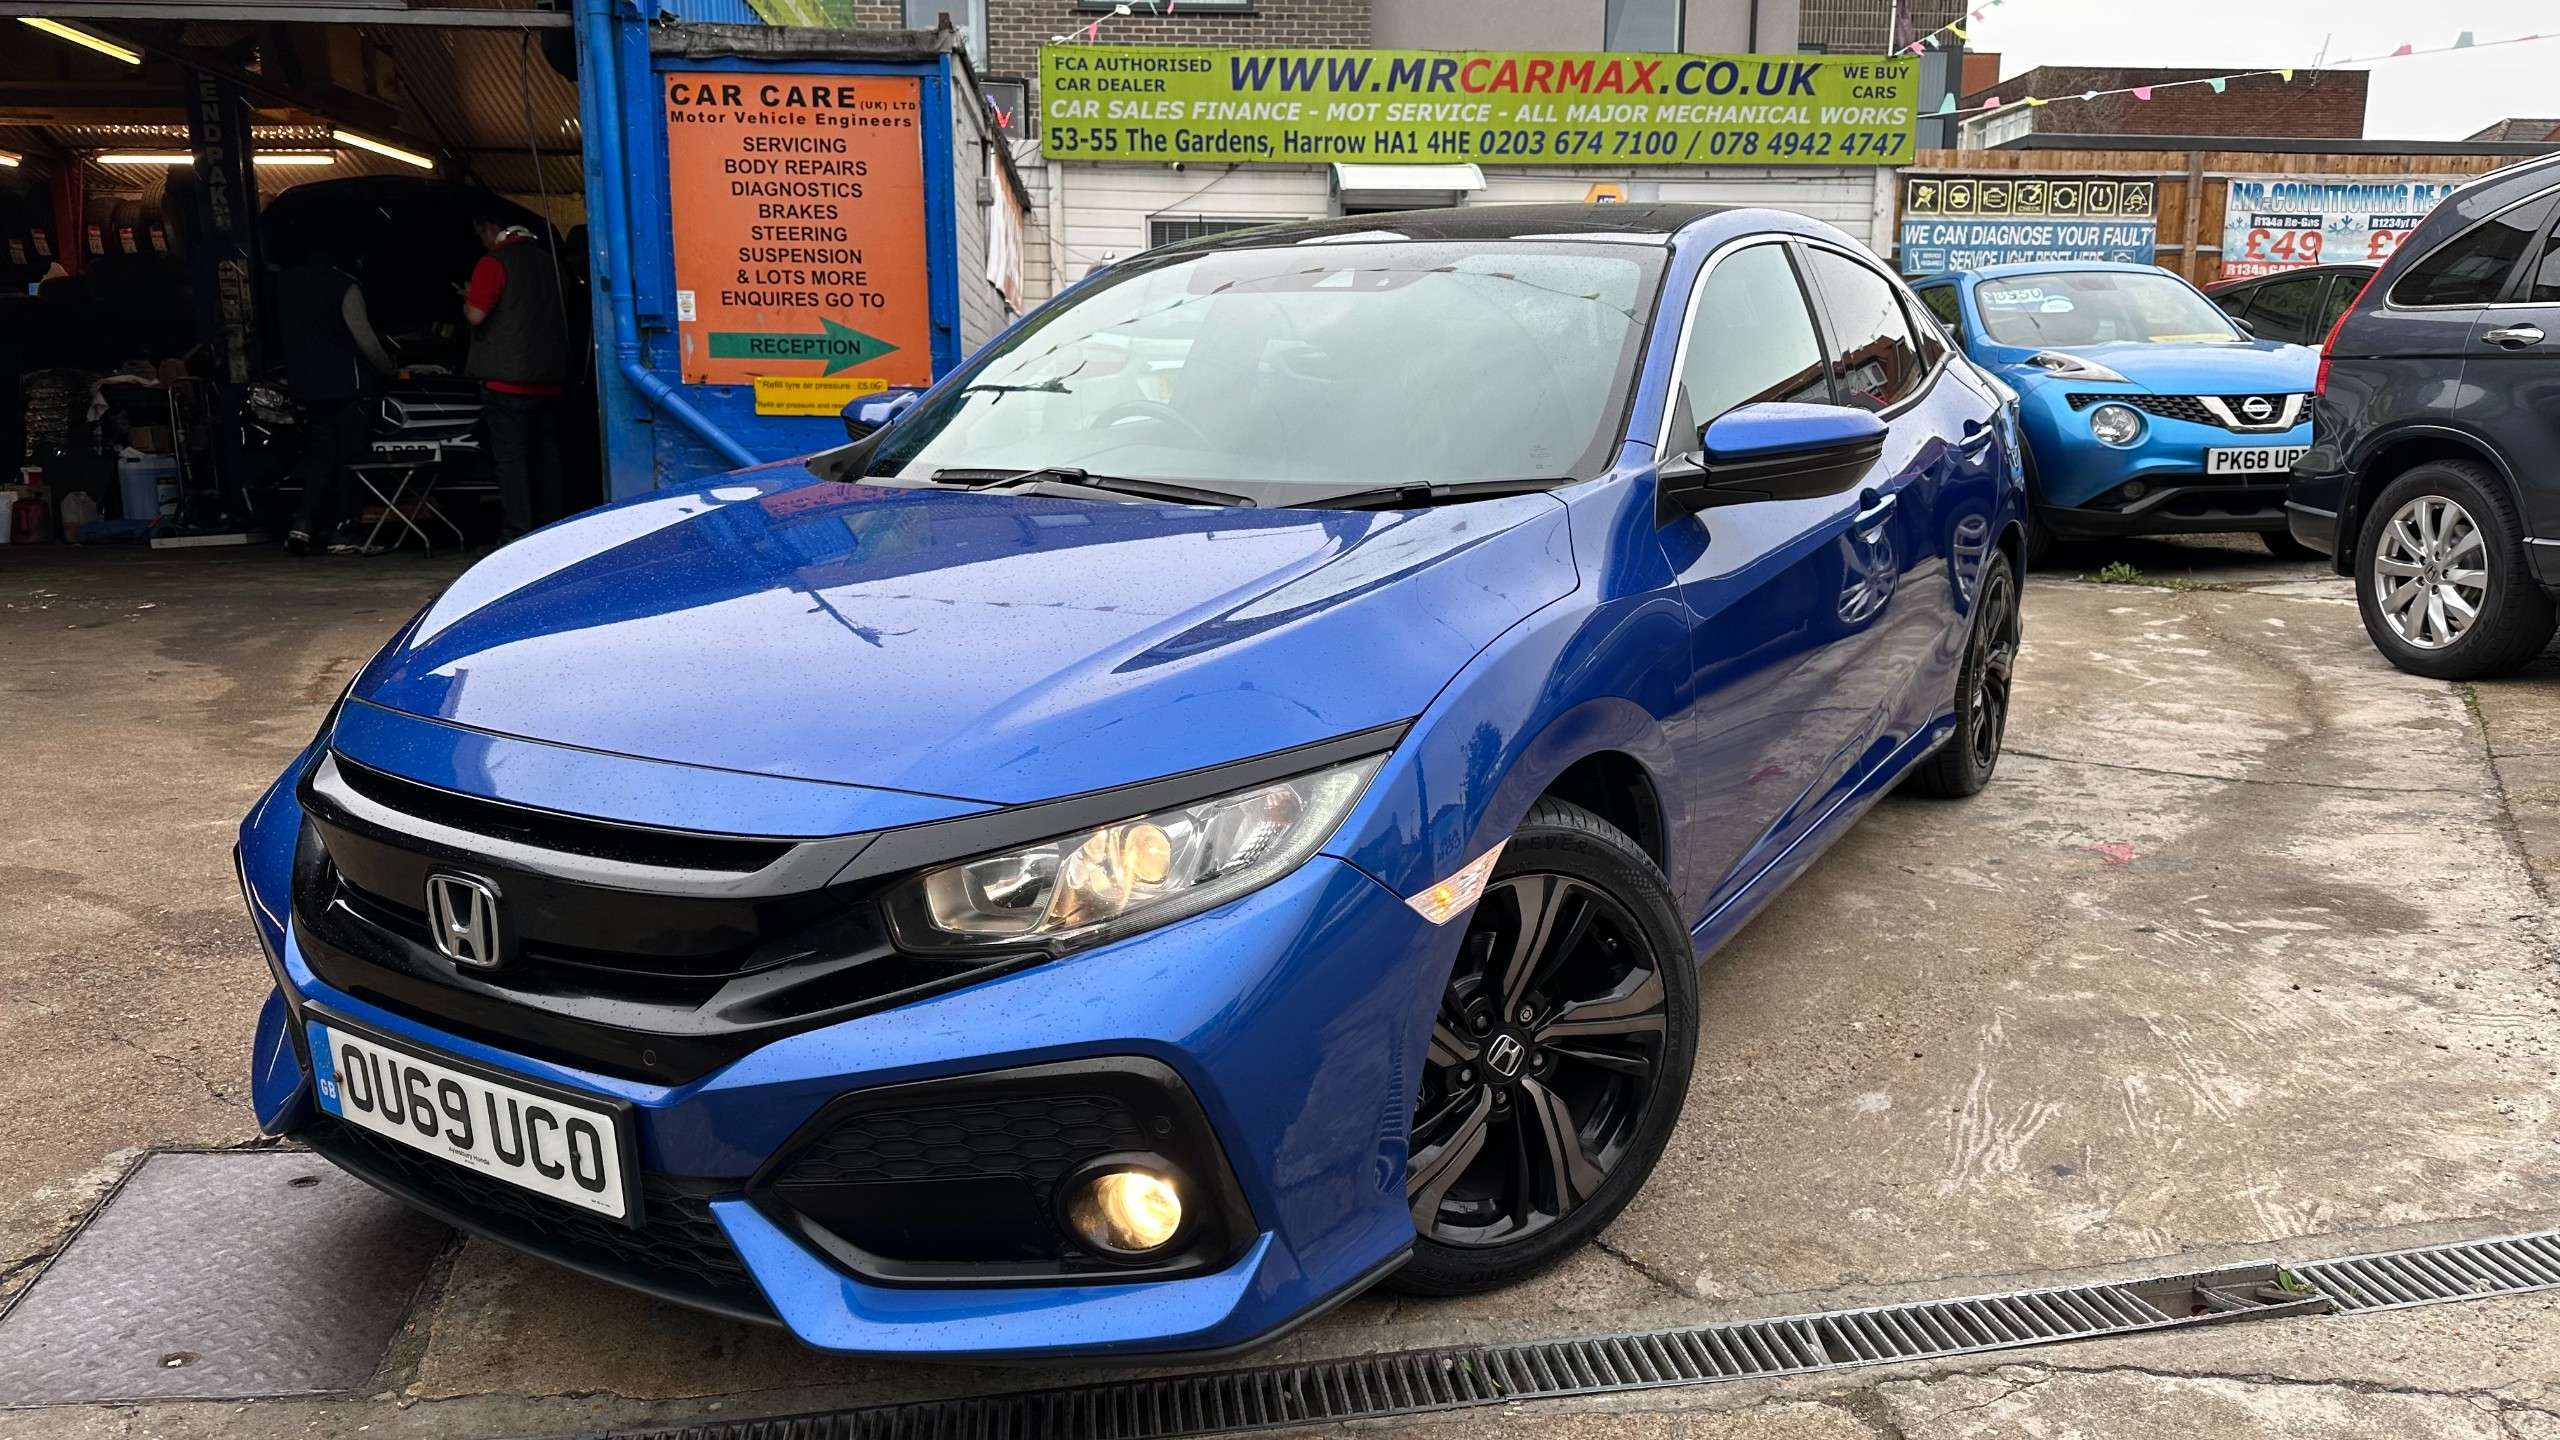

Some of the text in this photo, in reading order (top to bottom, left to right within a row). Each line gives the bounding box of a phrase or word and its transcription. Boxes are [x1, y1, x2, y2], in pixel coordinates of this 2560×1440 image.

[1055, 57, 1212, 72] FCA AUTHORISED
[1843, 66, 1909, 79] WE BUY
[1055, 77, 1165, 92] CAR DEALER
[1230, 56, 1822, 96] WWW.MRCARMAX.CO.UK
[670, 83, 916, 111] CAR CARE (UK) LTD
[1852, 85, 1897, 99] CARS
[671, 111, 912, 128] Motor Vehicle Engineers
[1050, 99, 1100, 119] CAR
[1107, 100, 1185, 120] SALES
[1192, 101, 1302, 121] FINANCE
[1327, 103, 1381, 121] MOT
[1386, 103, 1491, 122] SERVICE
[1514, 104, 1558, 122] ALL
[1566, 104, 1648, 123] MAJOR
[1655, 105, 1810, 124] MECHANICAL
[1820, 107, 1907, 125] WORKS
[743, 136, 847, 153] SERVICING
[1051, 127, 1117, 151] 53-55
[1126, 127, 1167, 152] The
[1175, 128, 1275, 158] Gardens,
[1284, 130, 1366, 154] Harrow
[1374, 131, 1418, 154] HA1
[1427, 131, 1470, 154] 4HE
[1479, 130, 1546, 155] 0203
[1555, 131, 1603, 155] 674
[1612, 131, 1677, 155] 7100
[1710, 131, 1759, 155] 078
[1767, 132, 1832, 156] 4942
[1840, 132, 1906, 156] 4747
[724, 159, 867, 175] BODY REPAIRS
[732, 181, 863, 198] DIAGNOSTICS
[2231, 183, 2408, 214] AIR-CONDITIONING
[759, 204, 838, 219] BRAKES
[2254, 217, 2282, 227] R134a
[751, 226, 847, 241] STEERING
[1904, 225, 2149, 246] WE CAN DIAGNOSE YOUR FAULT
[2245, 229, 2323, 260] £49
[739, 248, 862, 264] SUSPENSION
[1949, 250, 1998, 271] SERVICE
[737, 270, 867, 286] & LOTS MORE
[721, 291, 885, 308] ENQUIRES GO TO
[750, 338, 861, 355] RECEPTION
[815, 382, 851, 391] pressure
[2216, 449, 2309, 470] PK68 UP
[320, 1079, 337, 1099] GB
[341, 1044, 474, 1151] OU69
